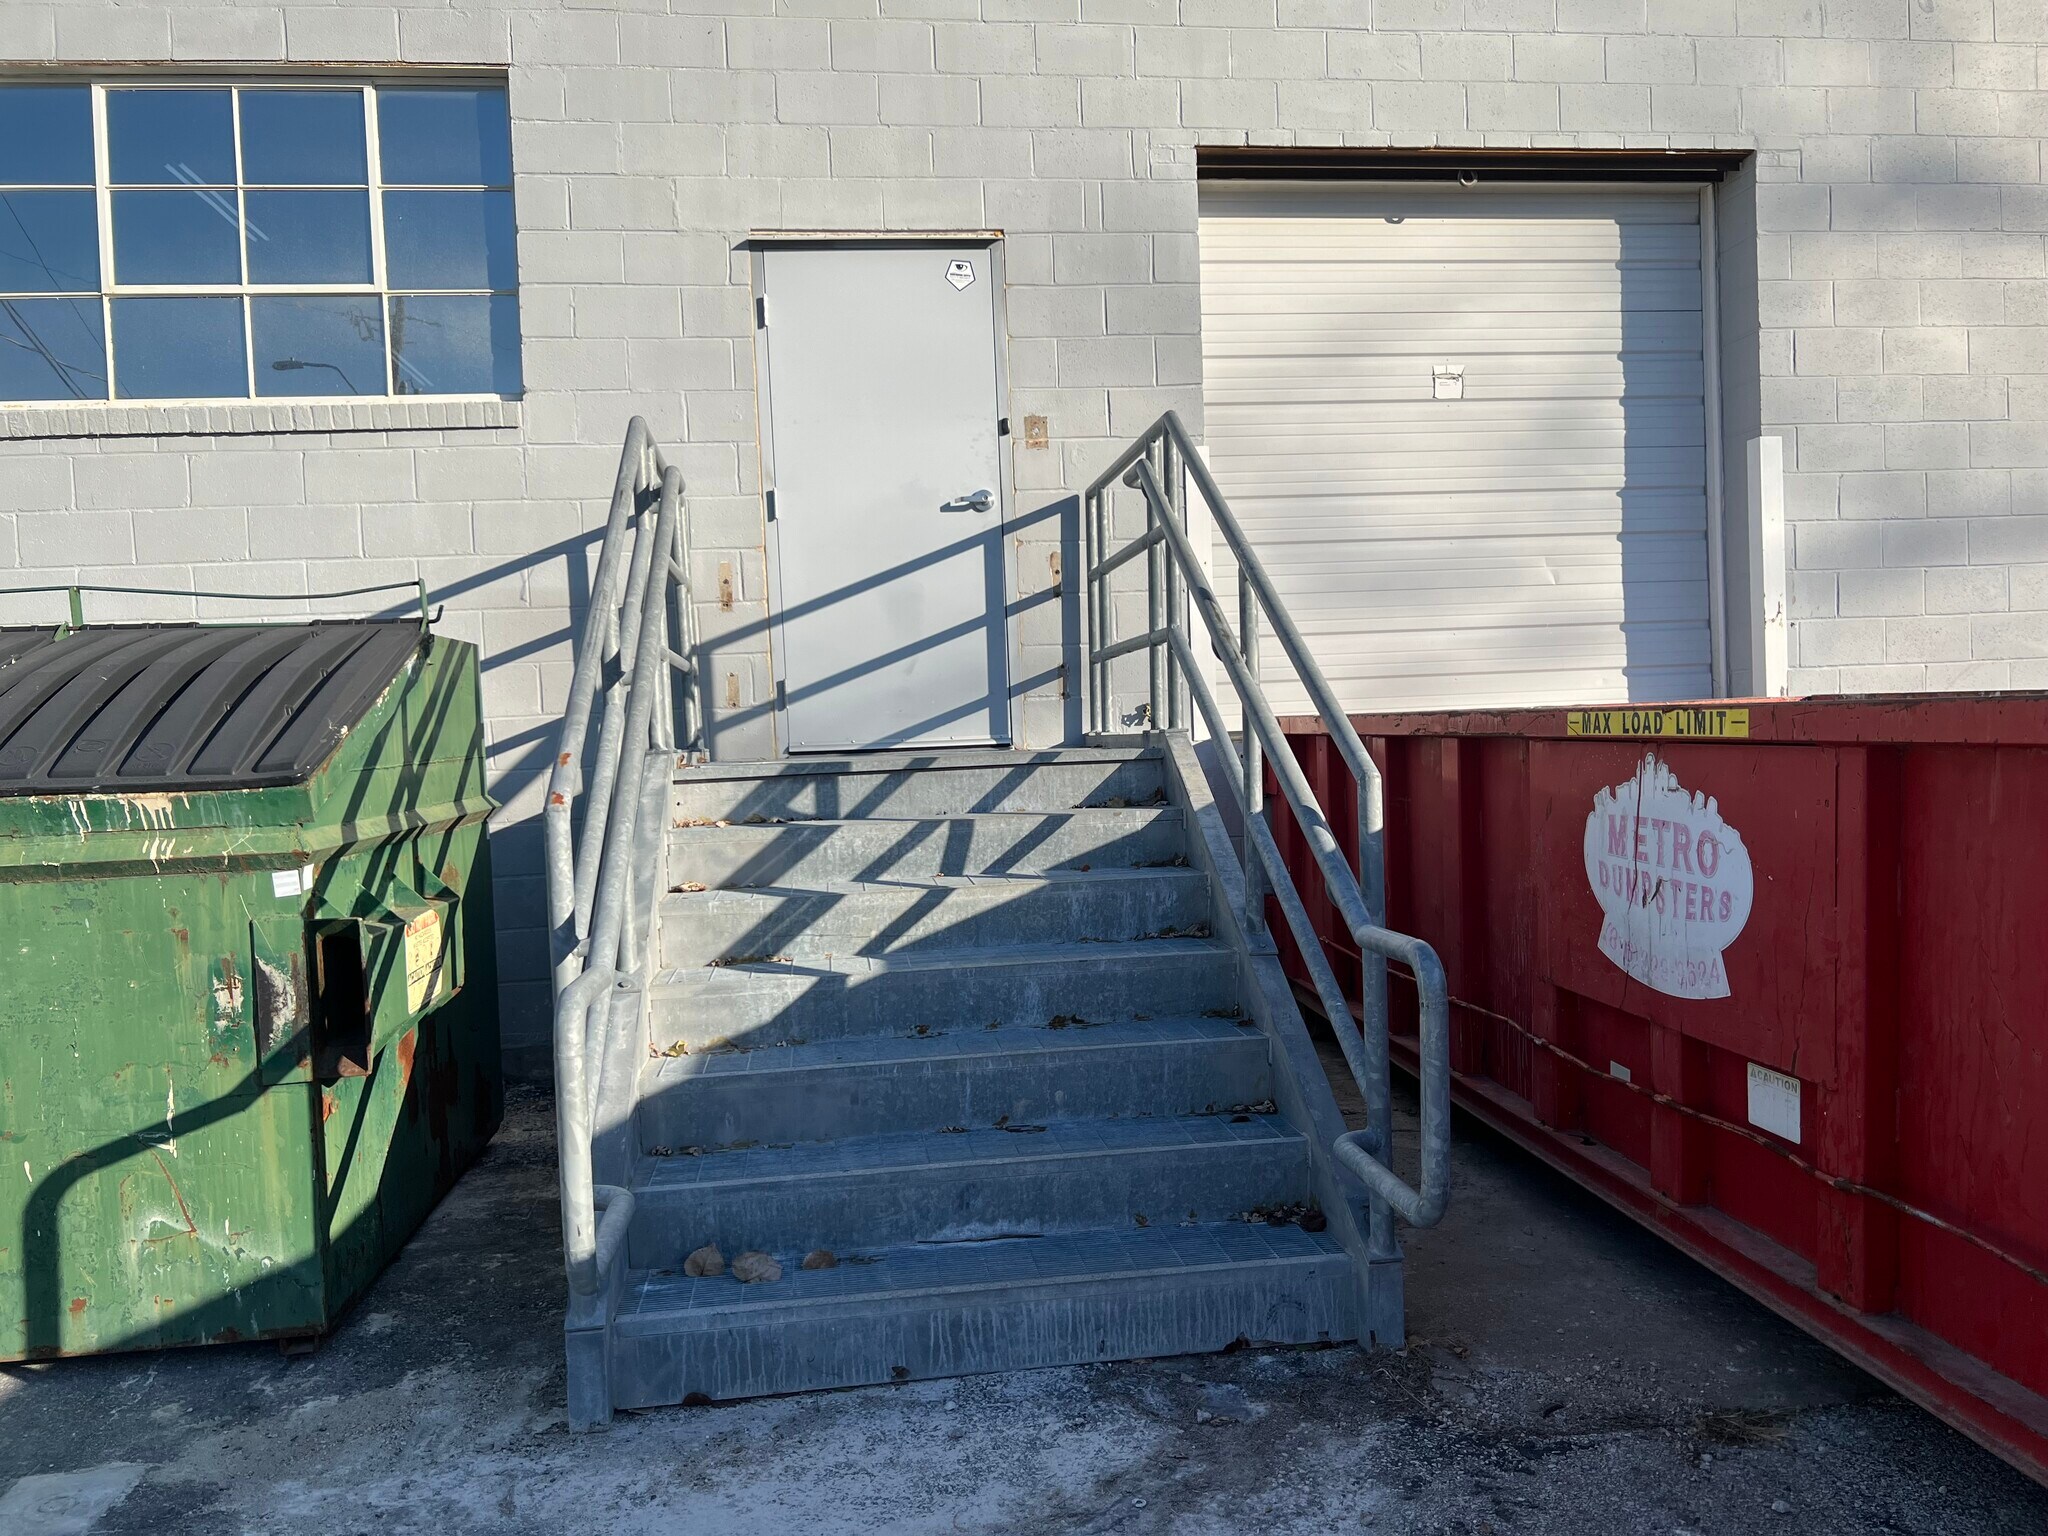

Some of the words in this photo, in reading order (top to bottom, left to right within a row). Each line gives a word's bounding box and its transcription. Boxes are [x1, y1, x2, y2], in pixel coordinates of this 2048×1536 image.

[1582, 712, 1611, 734] MAX
[1623, 711, 1663, 734] LOAD
[1676, 711, 1727, 735] LIMIT
[1608, 814, 1720, 878] METRO
[1598, 860, 1733, 922] DUMPSTERS
[1757, 1070, 1798, 1094] CAUTION
